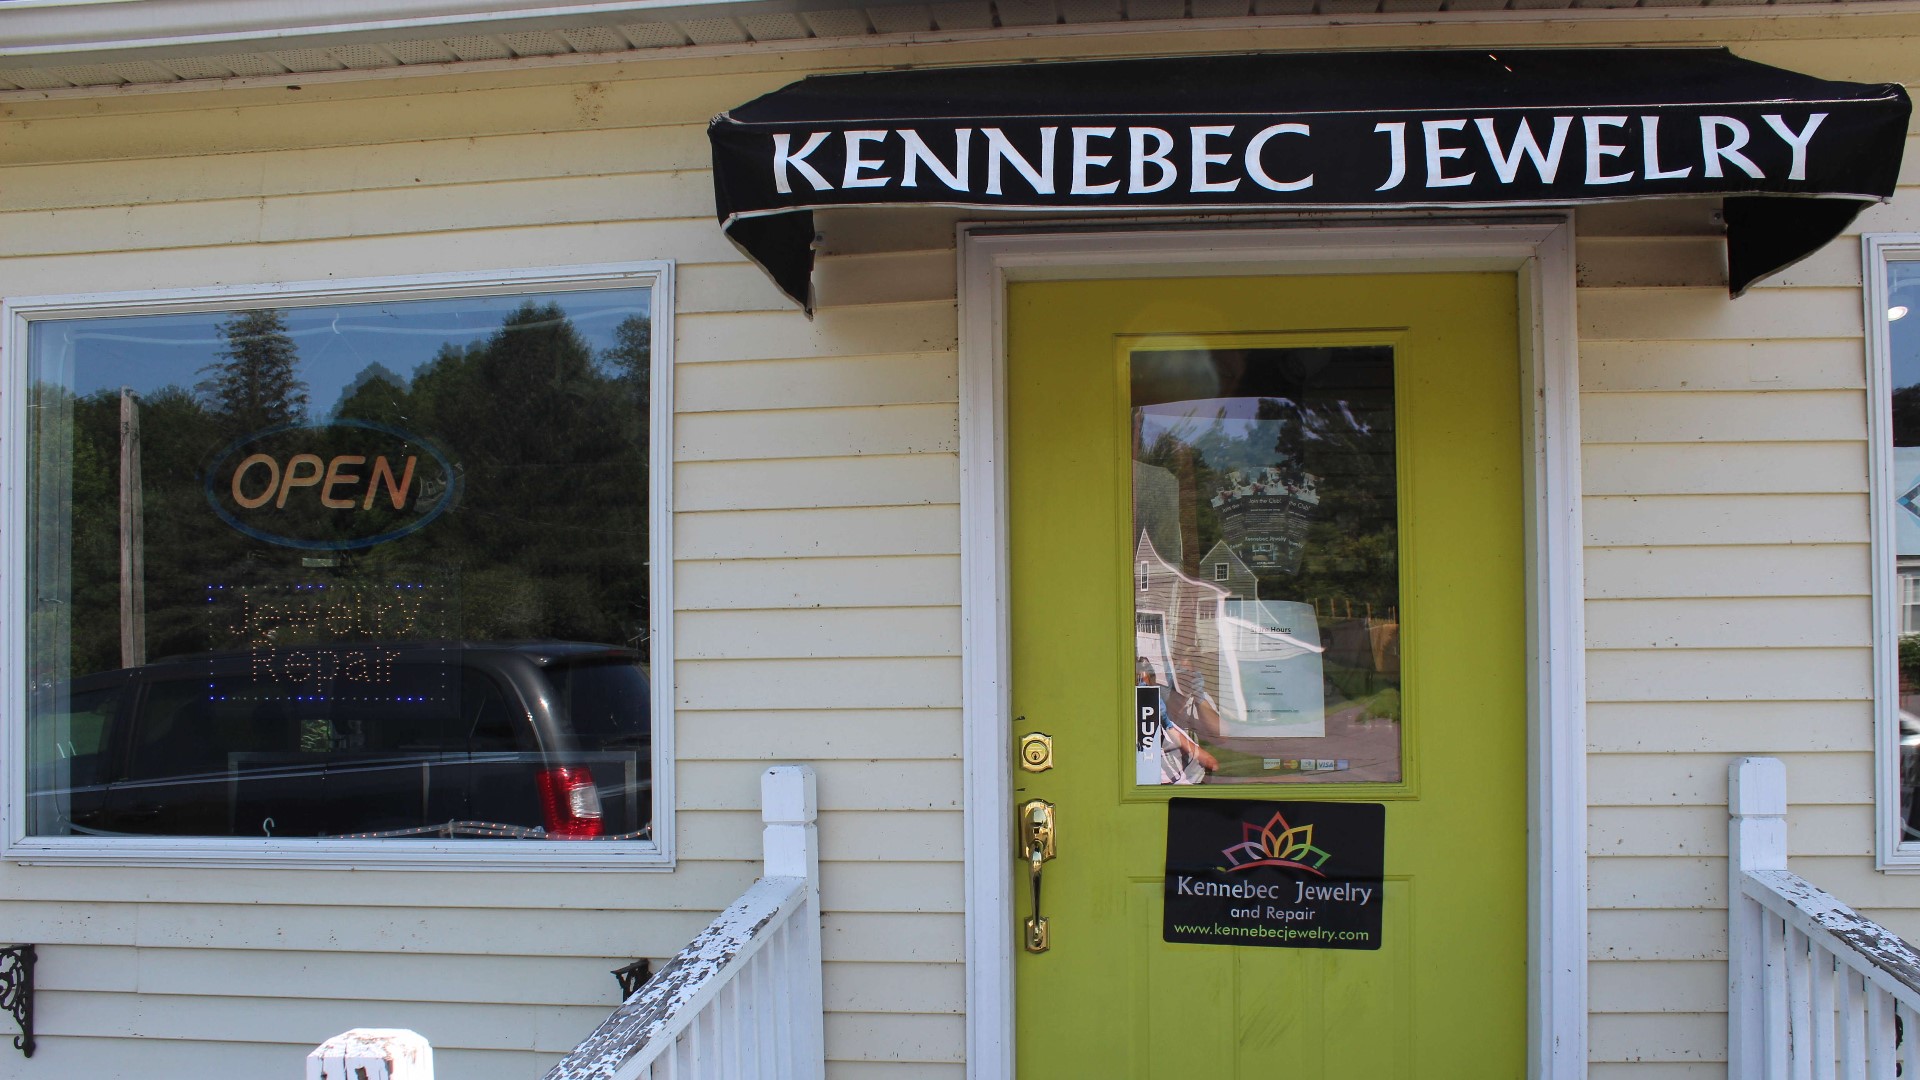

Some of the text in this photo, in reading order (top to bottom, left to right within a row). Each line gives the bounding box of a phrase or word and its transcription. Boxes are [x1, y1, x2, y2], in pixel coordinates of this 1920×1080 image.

[772, 113, 1830, 195] KENNEBEC JEWELRY
[231, 453, 417, 510] OPEN
[229, 592, 423, 636] Jewelry
[252, 639, 401, 693] Repair
[1177, 875, 1373, 906] Kennebec Jewelry
[1174, 922, 1369, 943] www.kennebecjewelry.com
[1230, 905, 1316, 923] and Repair
